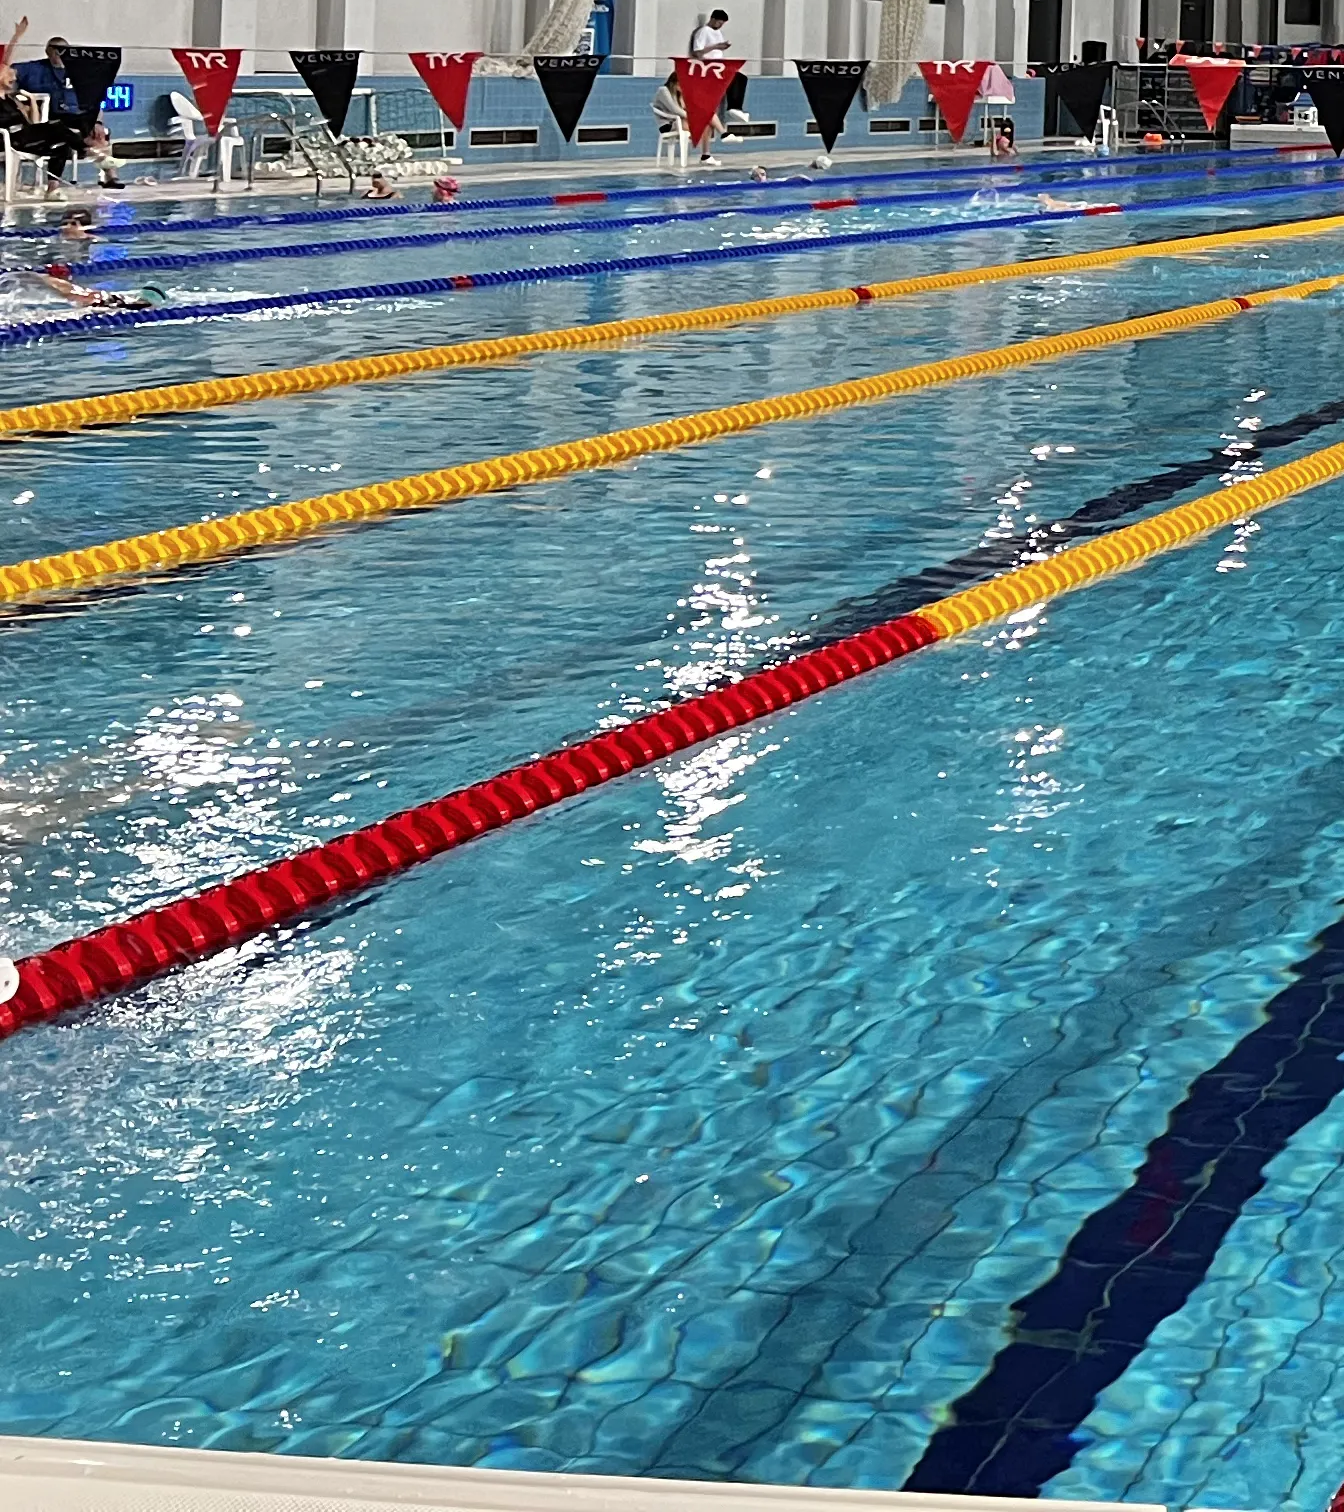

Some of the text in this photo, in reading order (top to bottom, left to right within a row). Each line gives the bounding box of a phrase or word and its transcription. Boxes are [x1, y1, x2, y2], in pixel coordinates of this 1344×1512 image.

[186, 52, 228, 69] TYR
[425, 53, 466, 69] TYR
[933, 60, 975, 75] TYR
[687, 59, 725, 79] TYR
